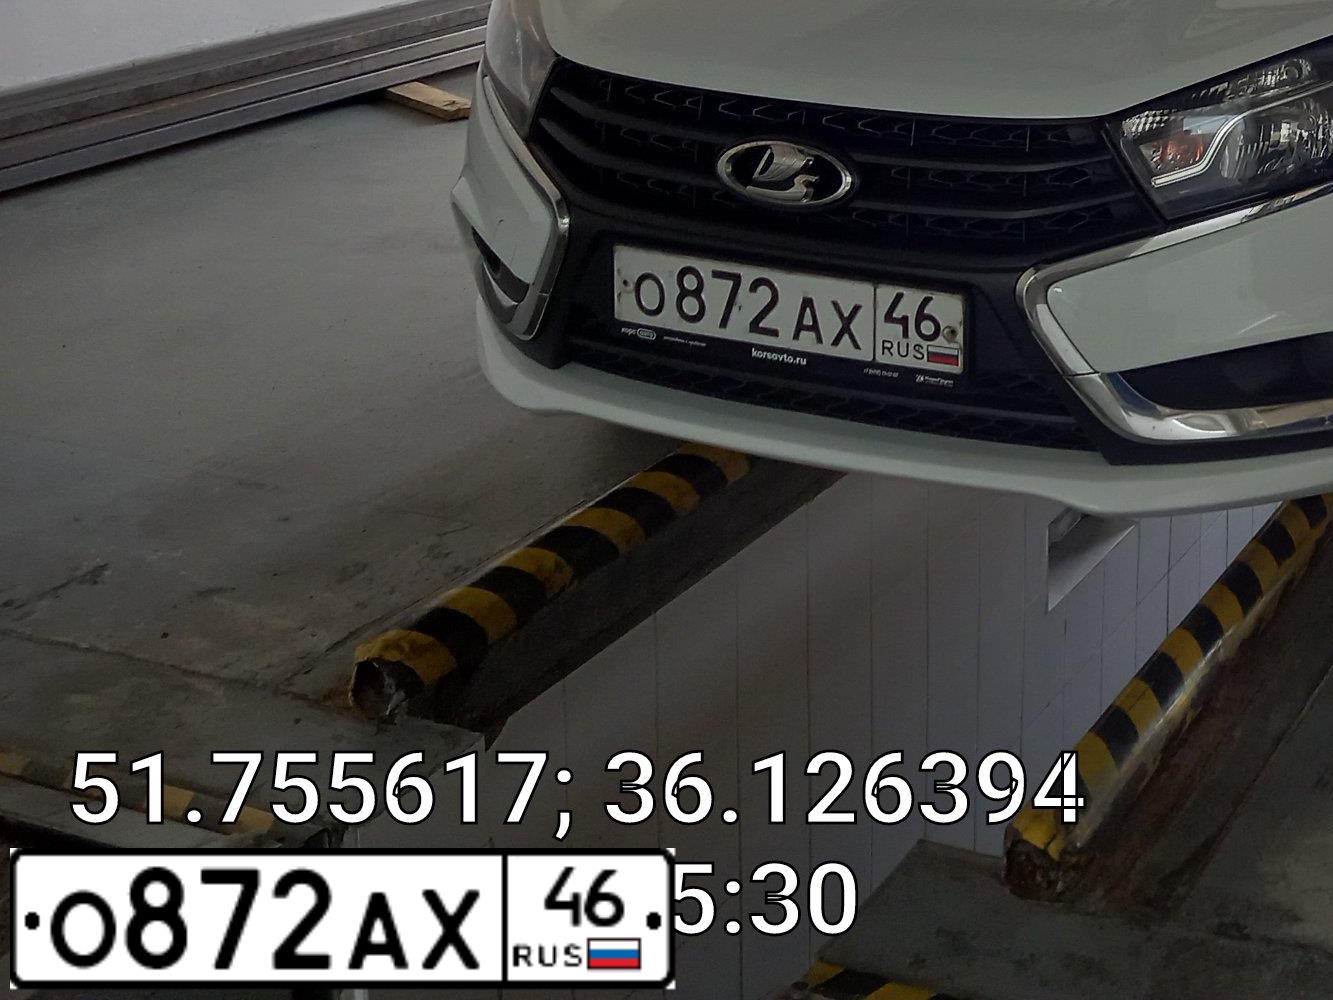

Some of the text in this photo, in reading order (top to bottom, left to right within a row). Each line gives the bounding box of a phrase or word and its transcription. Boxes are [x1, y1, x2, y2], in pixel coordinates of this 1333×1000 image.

[883, 291, 942, 342] 46
[751, 347, 807, 365] korsavto.ru
[880, 339, 925, 361] RUS
